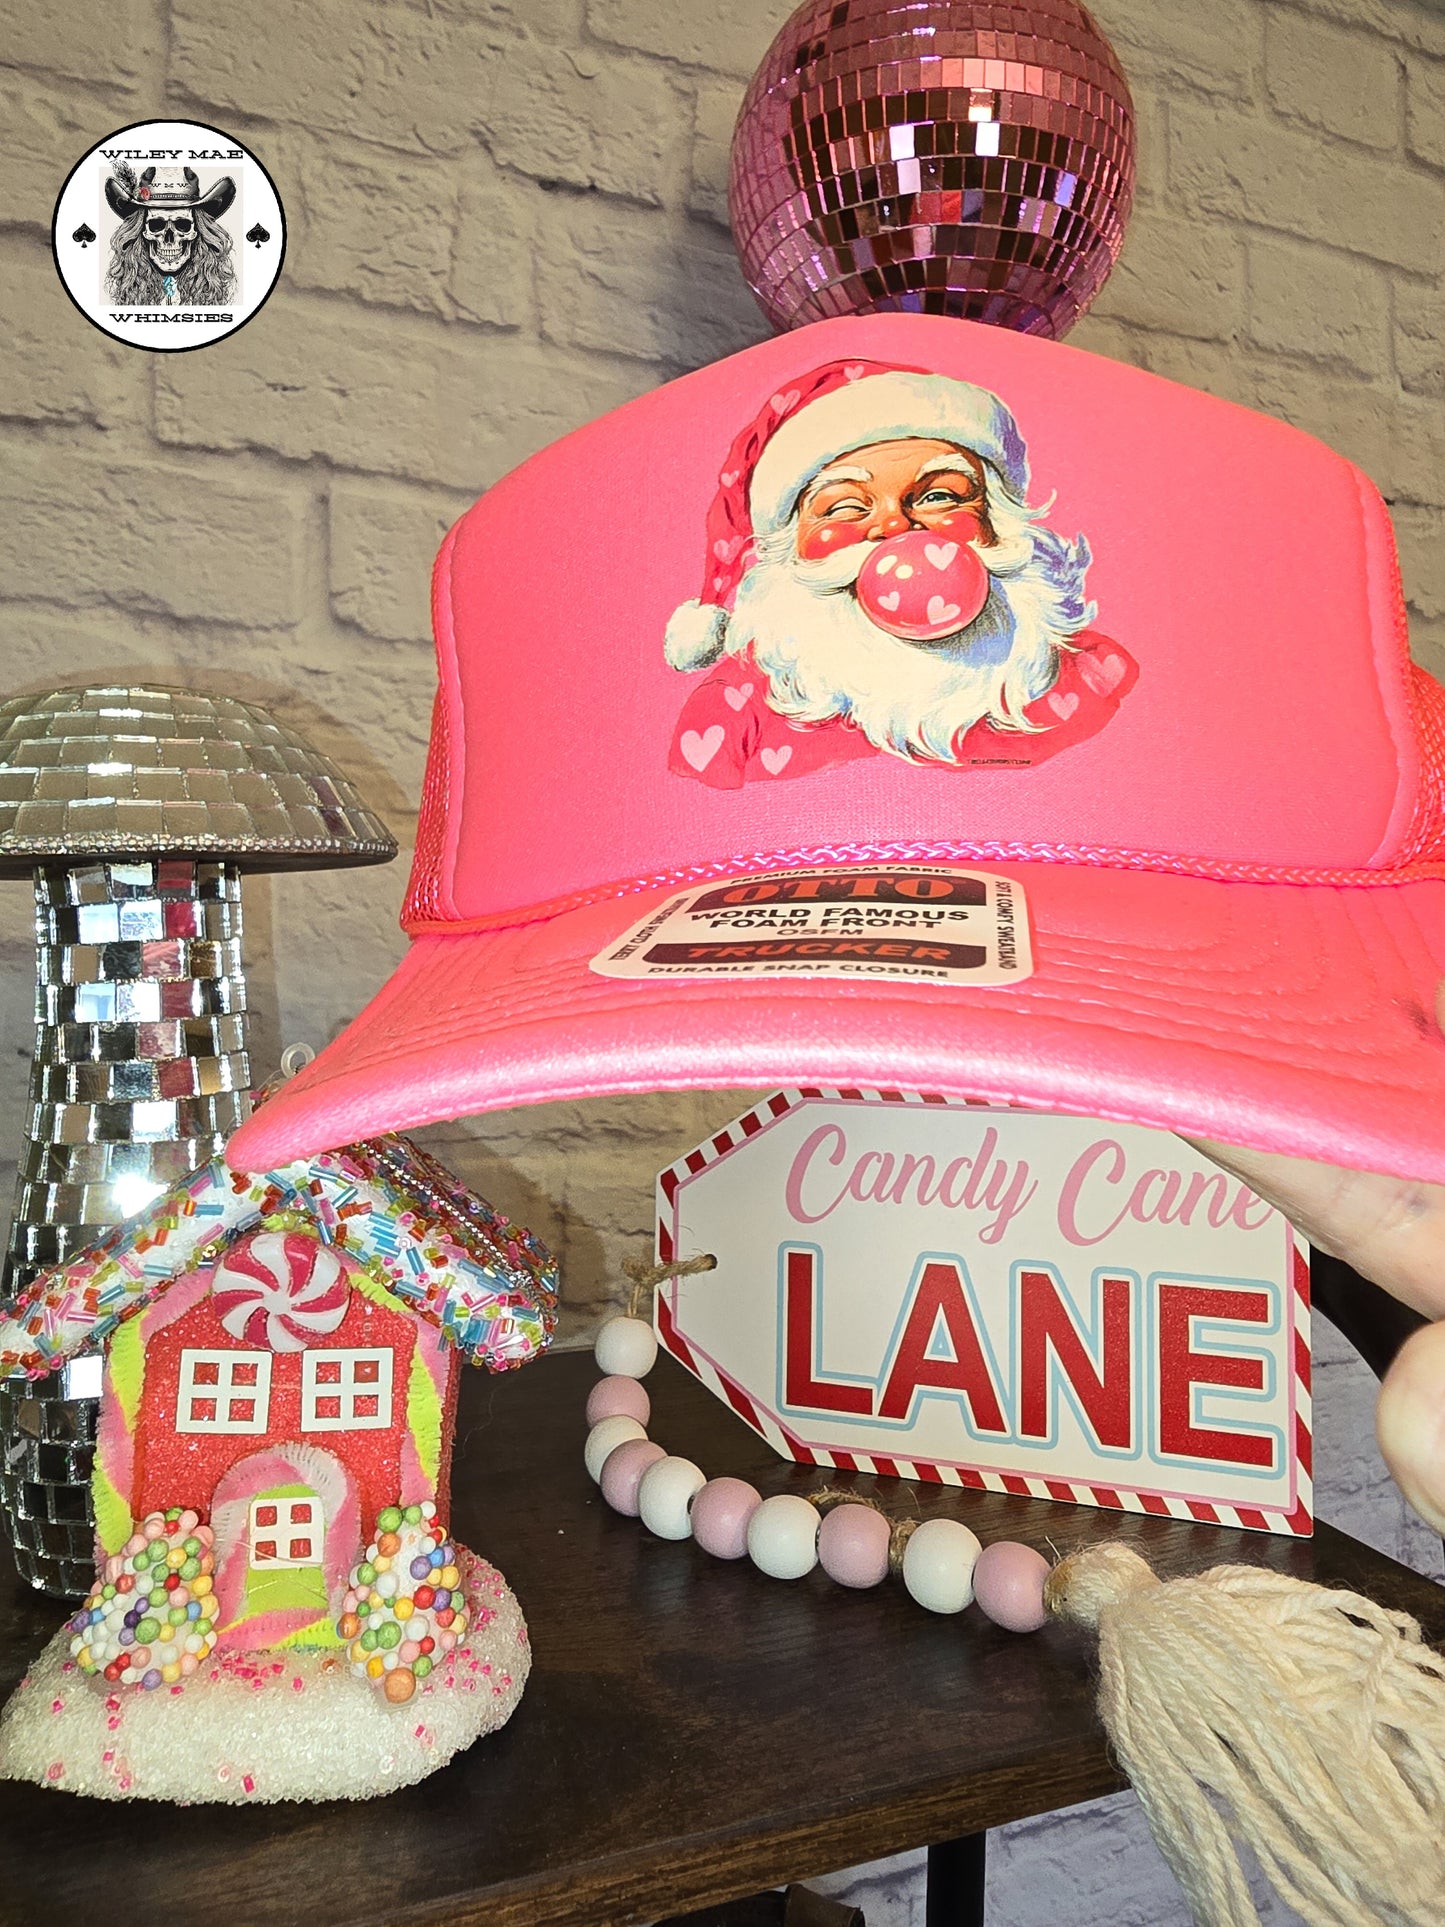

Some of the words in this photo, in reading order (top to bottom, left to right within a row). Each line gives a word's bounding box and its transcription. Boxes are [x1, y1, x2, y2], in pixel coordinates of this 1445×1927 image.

[730, 869, 816, 885] PREMIUM
[822, 866, 880, 874] FOAM
[885, 866, 953, 874] FABRIC
[723, 877, 954, 903] OTTO
[691, 908, 811, 921] WORLD
[823, 907, 970, 920] FAMOUS
[996, 898, 1014, 924] COMFY
[709, 918, 809, 928] FOAM
[820, 917, 942, 929] FRONT
[776, 928, 864, 936] OSFM
[687, 943, 952, 961] TRUCKER
[648, 965, 755, 973] DURABLE
[839, 964, 948, 978] CLOSURE
[785, 1123, 1039, 1245] Candy
[1057, 1139, 1275, 1247] Cane
[783, 1250, 1276, 1469] LANE
